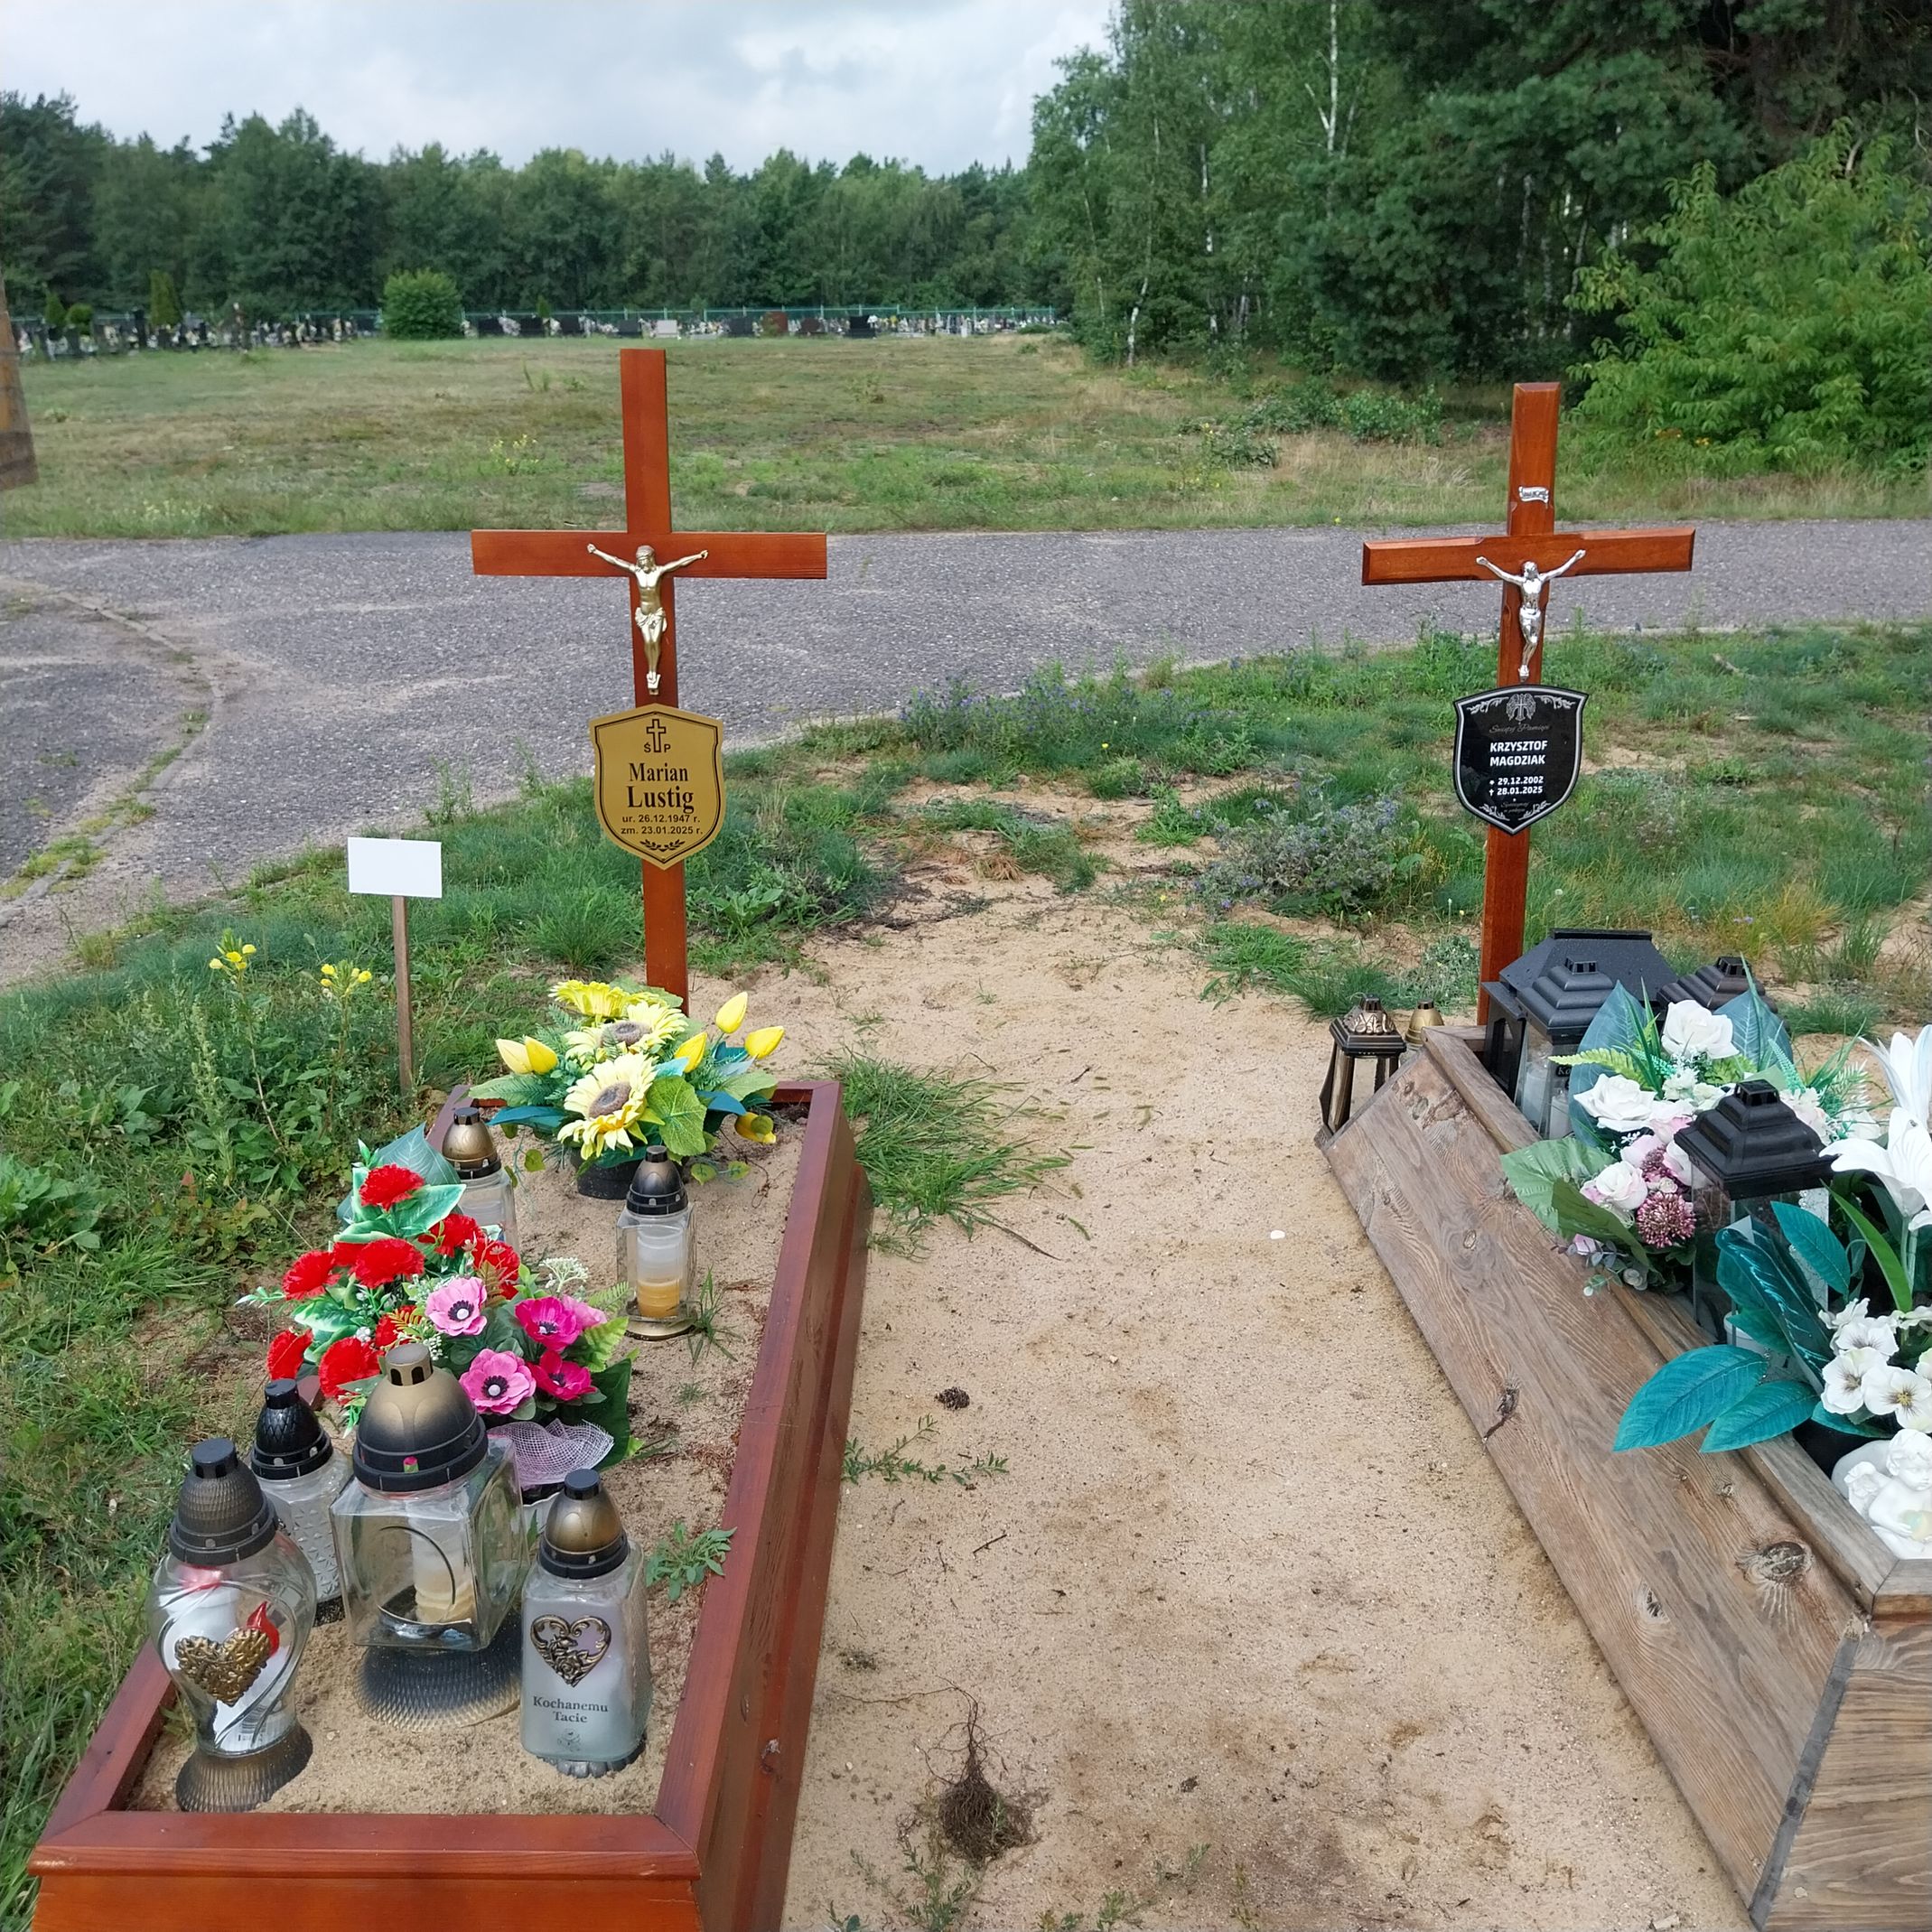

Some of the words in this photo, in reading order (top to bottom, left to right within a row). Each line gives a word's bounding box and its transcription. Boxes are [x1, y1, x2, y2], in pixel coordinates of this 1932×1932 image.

[644, 742, 651, 753] Ś
[664, 743, 671, 753] P
[1490, 741, 1548, 752] KRZYSZTOF
[1490, 755, 1545, 766] MAGDZIAK
[629, 762, 689, 781] Marian
[1498, 776, 1544, 786] 29.12.2002
[1498, 786, 1543, 795] 28.01.2025
[628, 786, 695, 813] Lustig
[639, 815, 690, 823] 26.12.1947
[641, 826, 694, 835] 23.01.2025
[533, 1696, 609, 1713] Kochanemu
[553, 1711, 588, 1722] Tacie
